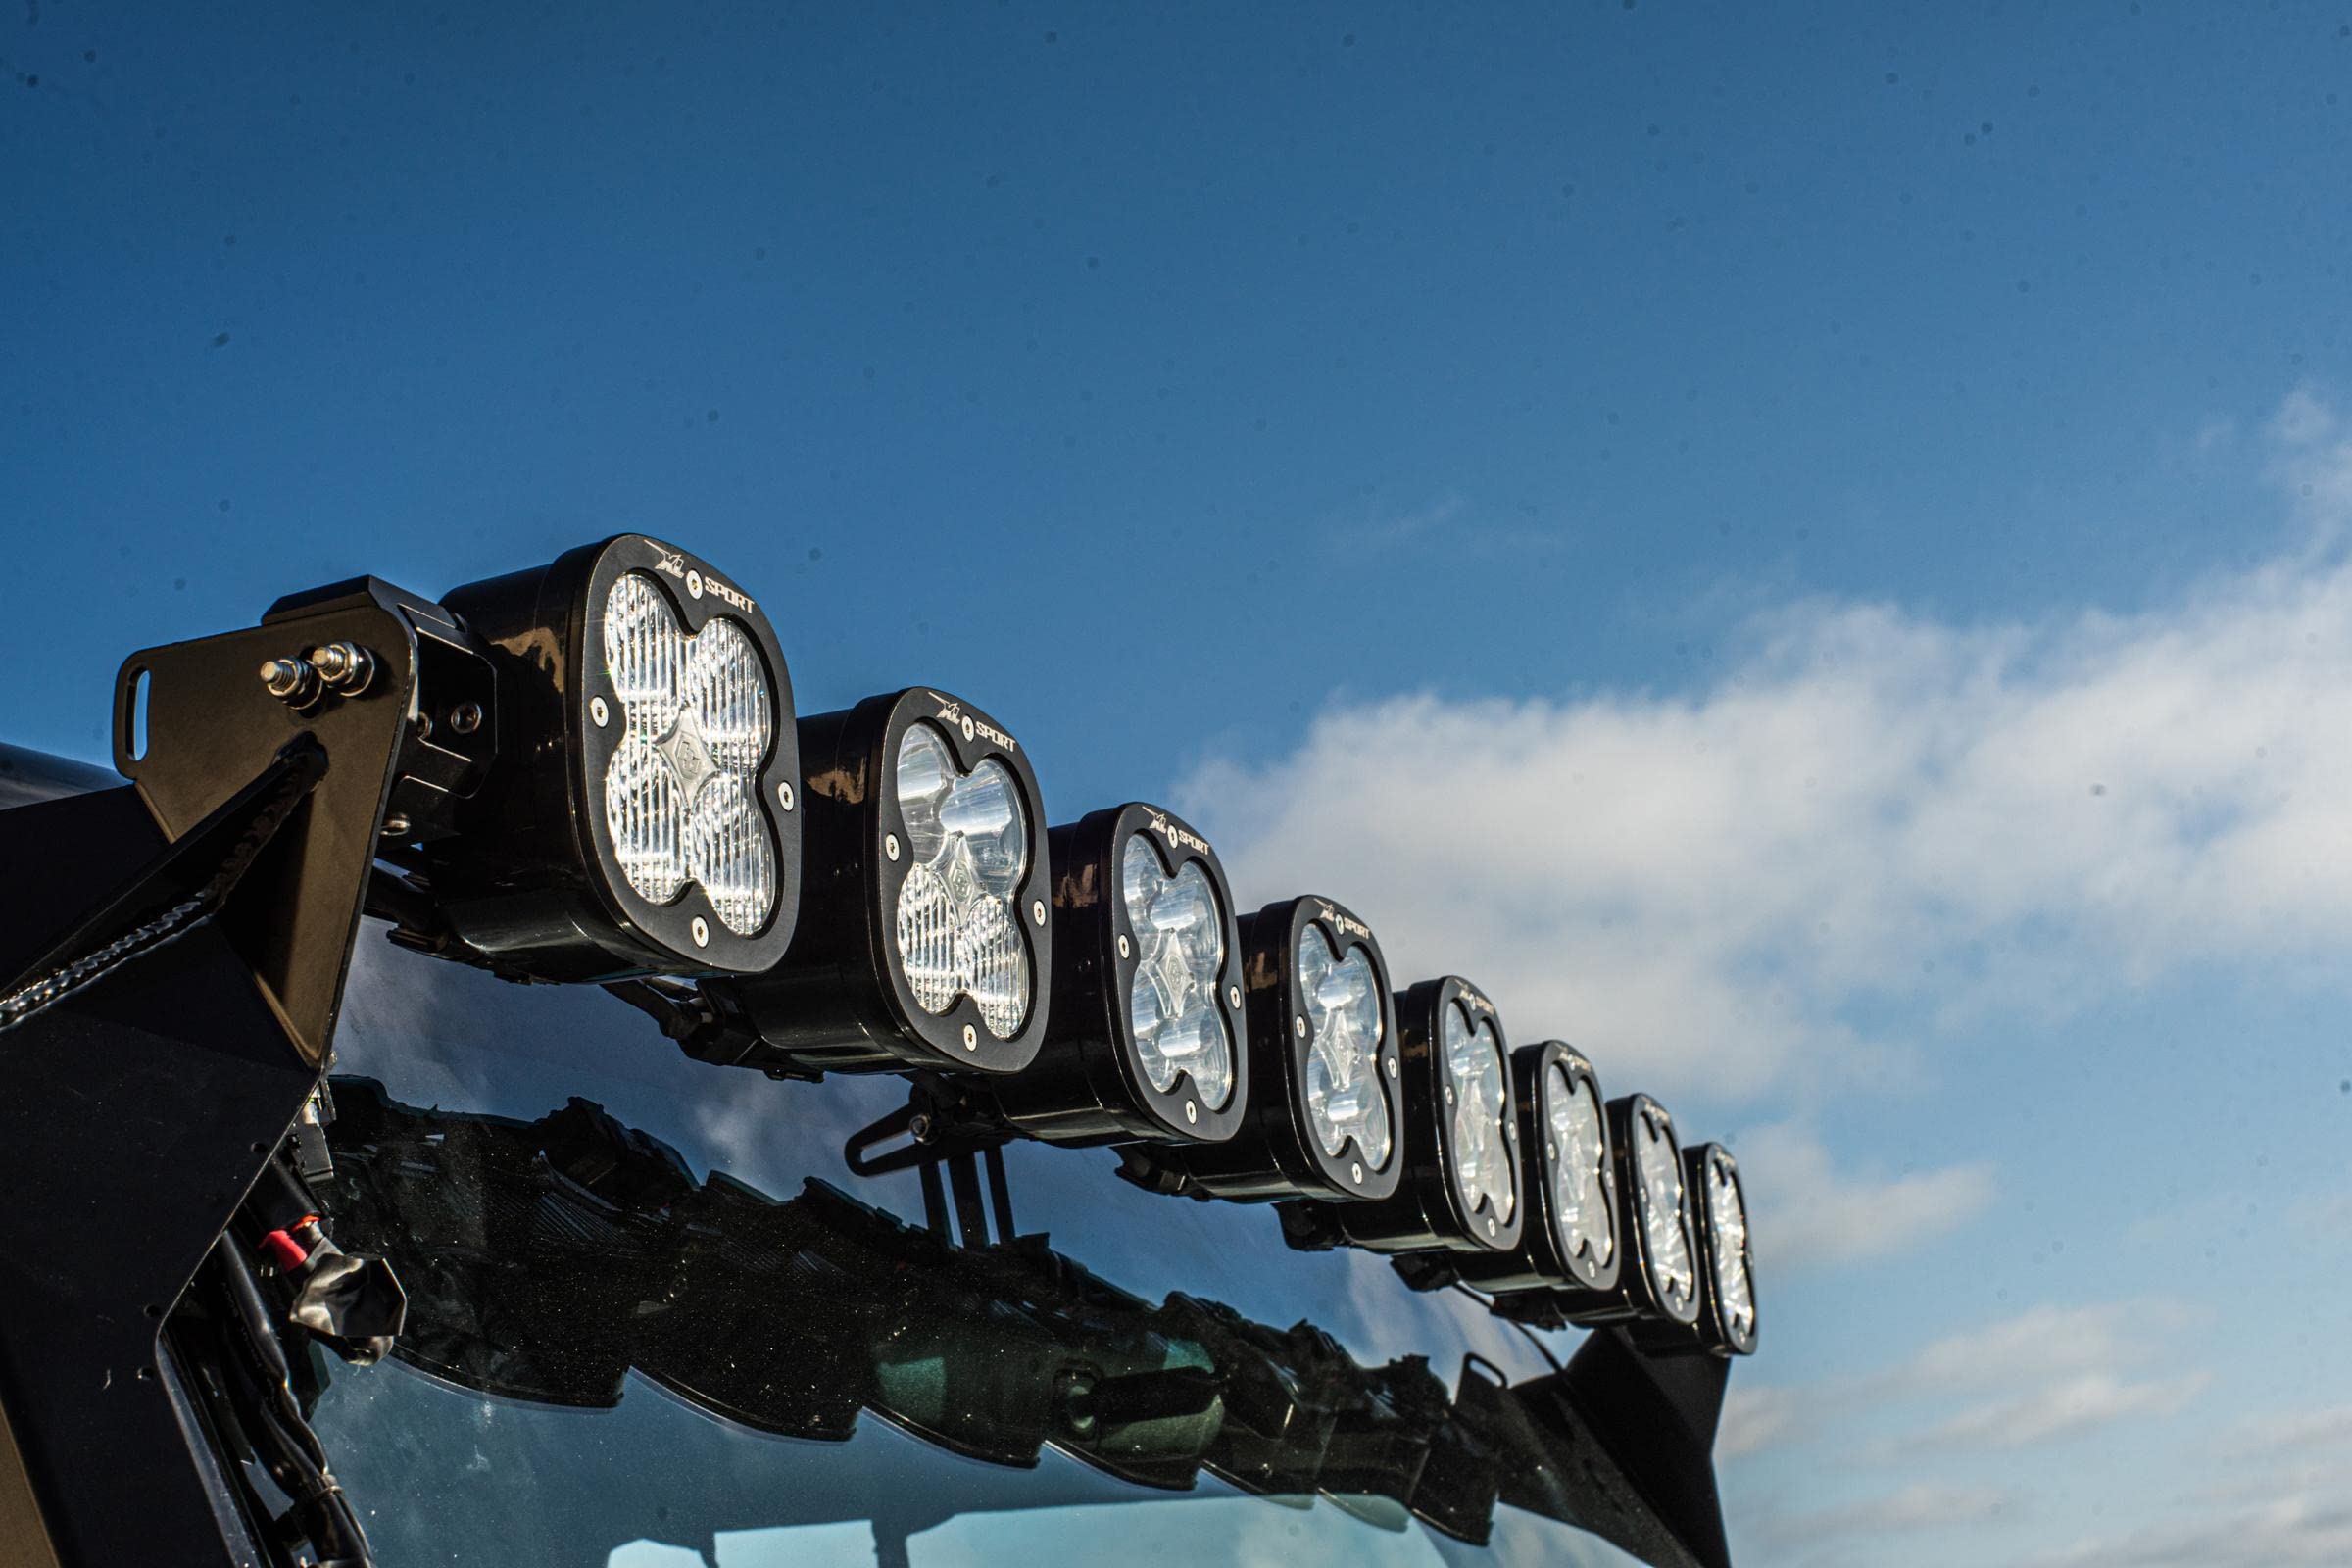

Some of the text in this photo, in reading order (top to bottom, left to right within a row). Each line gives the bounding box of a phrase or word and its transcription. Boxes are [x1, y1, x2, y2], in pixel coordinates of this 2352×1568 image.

[705, 576, 755, 613] SPORT
[975, 721, 1015, 752] SPORT
[1178, 830, 1208, 855] SPORT
